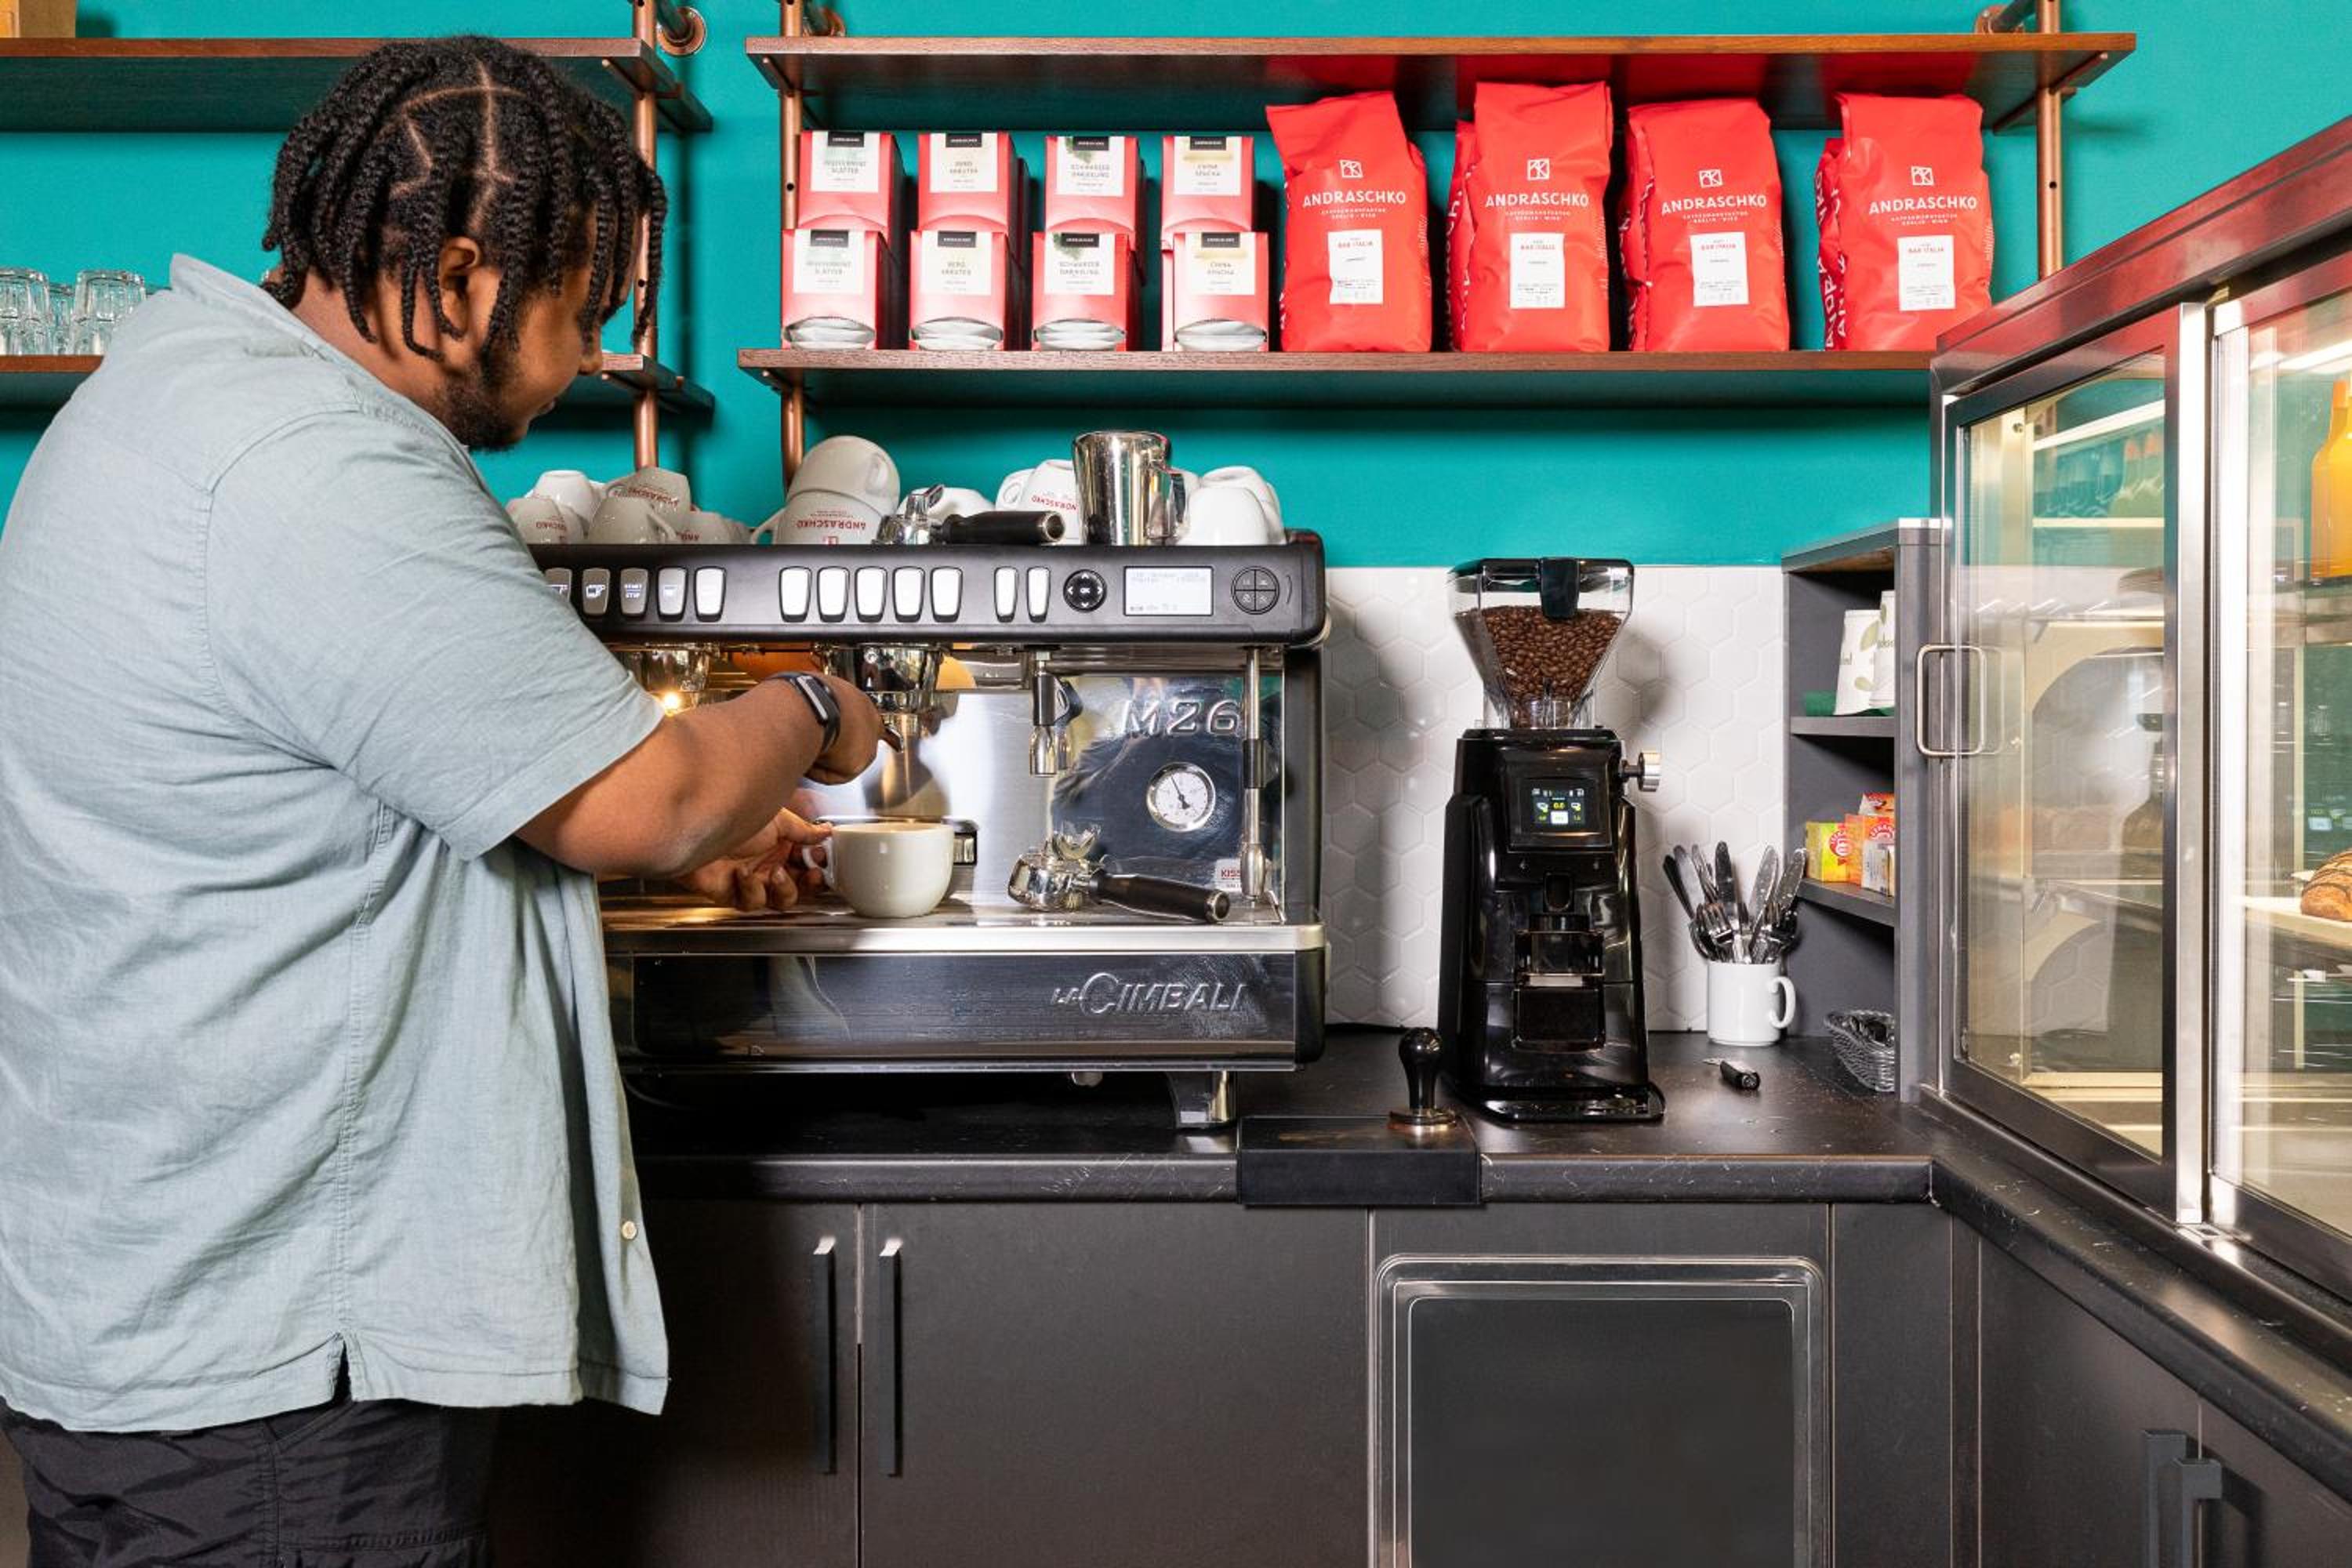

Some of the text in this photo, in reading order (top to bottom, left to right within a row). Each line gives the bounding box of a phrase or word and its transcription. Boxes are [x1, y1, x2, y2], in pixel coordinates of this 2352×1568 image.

[1302, 190, 1406, 208] ANDRASCHKO
[1485, 191, 1590, 209] ANDRASCHKO
[1661, 194, 1767, 216] ANDRASCHKO
[1868, 196, 1978, 216] ANDRASCHKO
[1030, 495, 1078, 511] NDRASCHKO
[796, 519, 866, 531] ANDRASCHKO
[1119, 698, 1242, 737] M26
[1080, 971, 1247, 1014] CIMBALI
